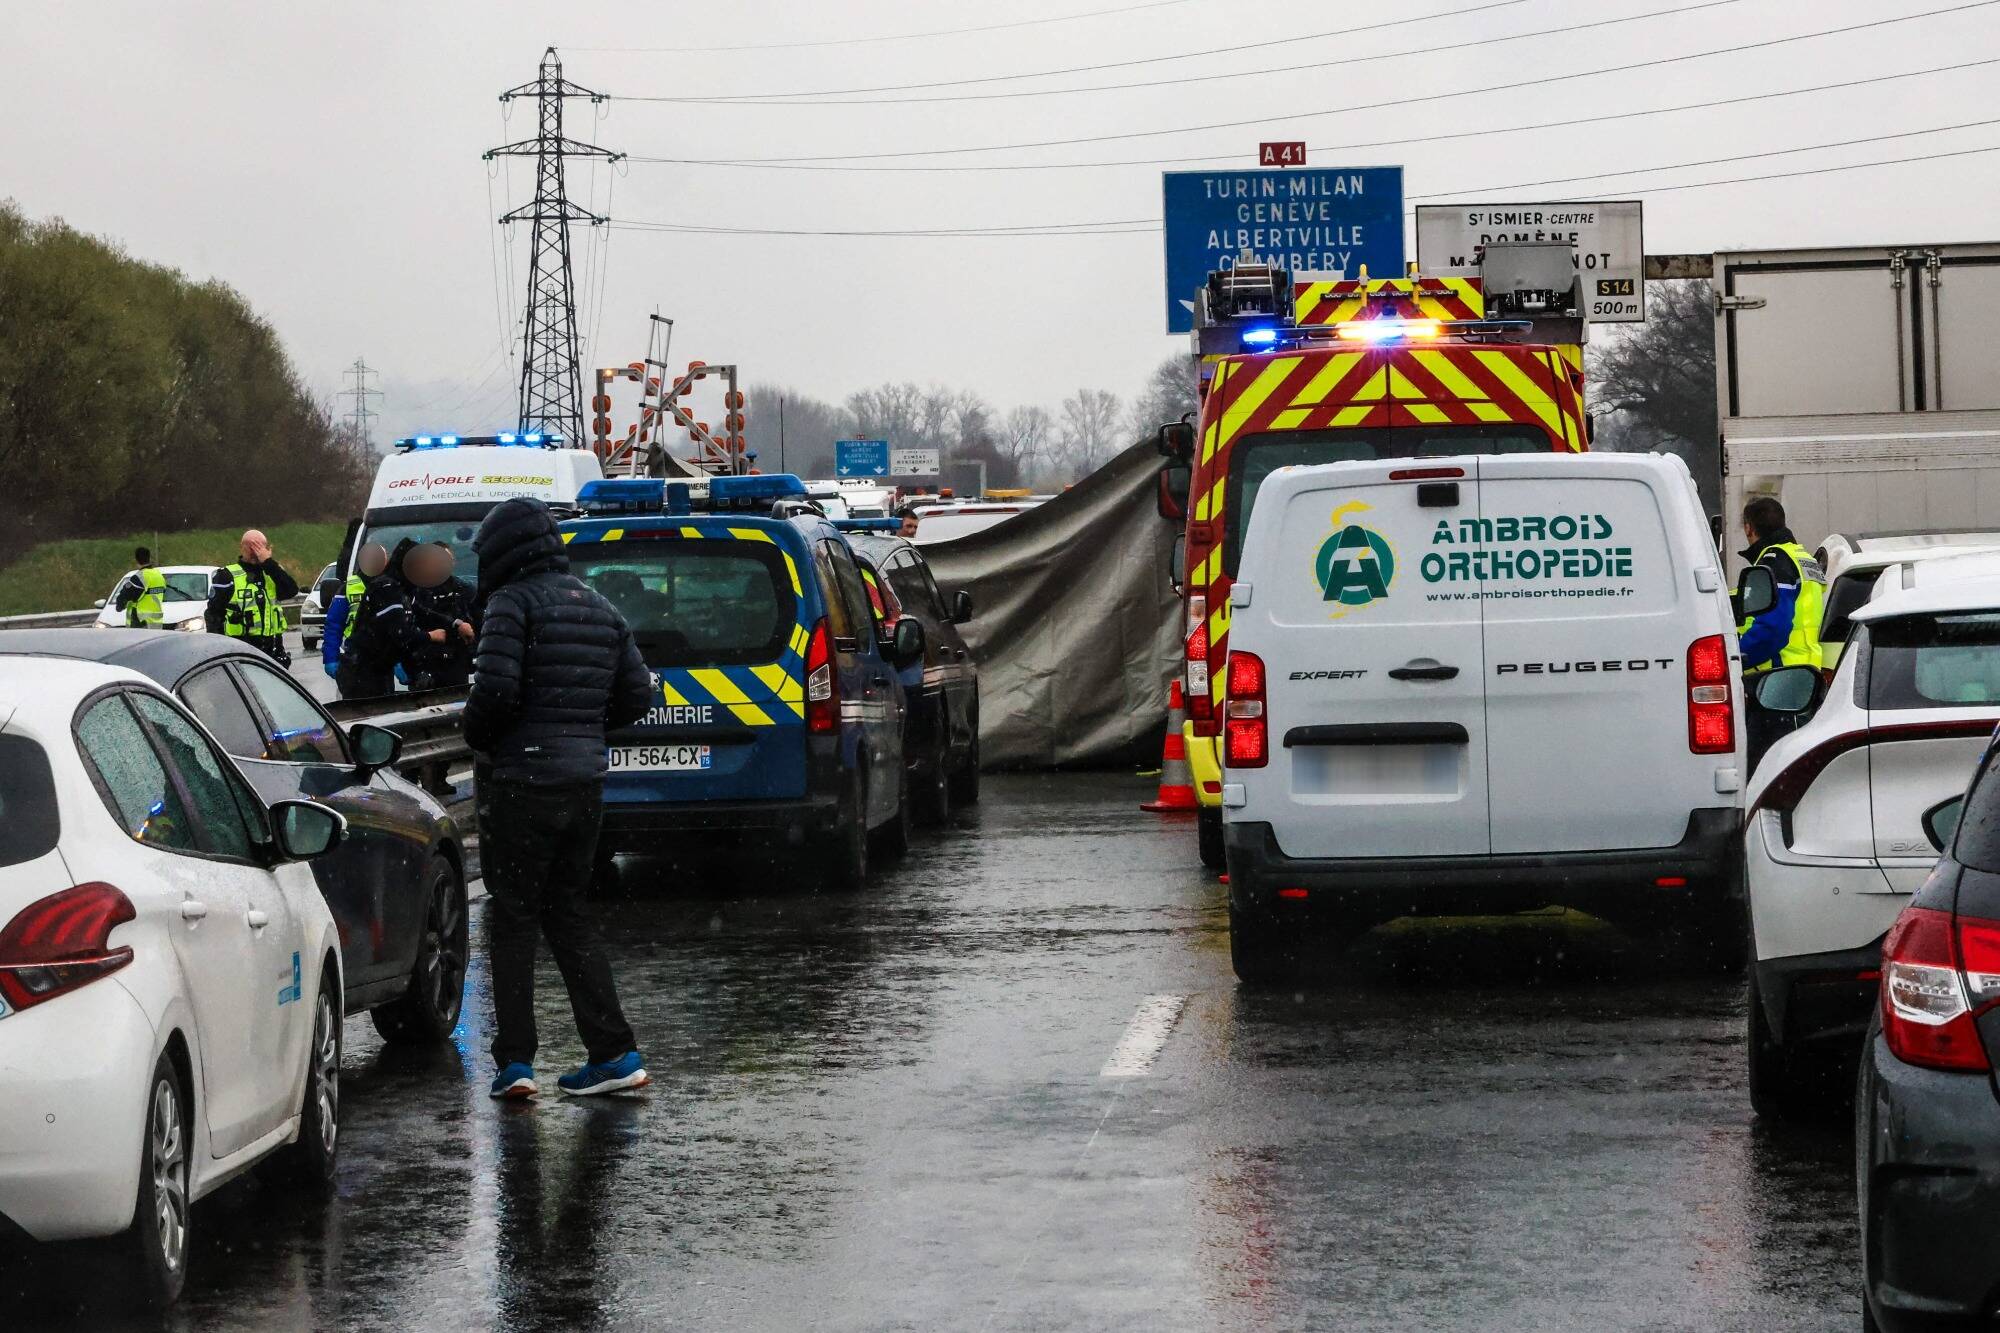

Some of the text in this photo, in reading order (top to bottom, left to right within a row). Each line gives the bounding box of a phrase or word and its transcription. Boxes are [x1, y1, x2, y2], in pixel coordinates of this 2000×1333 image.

[1264, 145, 1303, 162] A 41
[1203, 175, 1363, 198] TURIN-MILAN
[1237, 198, 1331, 223] GENÈVE
[1488, 212, 1543, 225] ISMIER
[1207, 225, 1363, 249] ALBERTVILLE
[1601, 281, 1630, 294] S 14
[1593, 301, 1638, 315] 500 m
[480, 475, 553, 486] SECOURS
[400, 491, 537, 502] AIDE MEDICALE URGENTE
[1432, 514, 1613, 544] AMBROIS
[1420, 547, 1633, 583] ORTHOPEDIE
[1426, 587, 1635, 602] www.ambroisorthopedie.fr
[1496, 658, 1674, 675] PEUGEOT
[1288, 669, 1368, 681] EXPERT
[611, 747, 699, 767] DT-564-CX
[702, 756, 710, 764] 75
